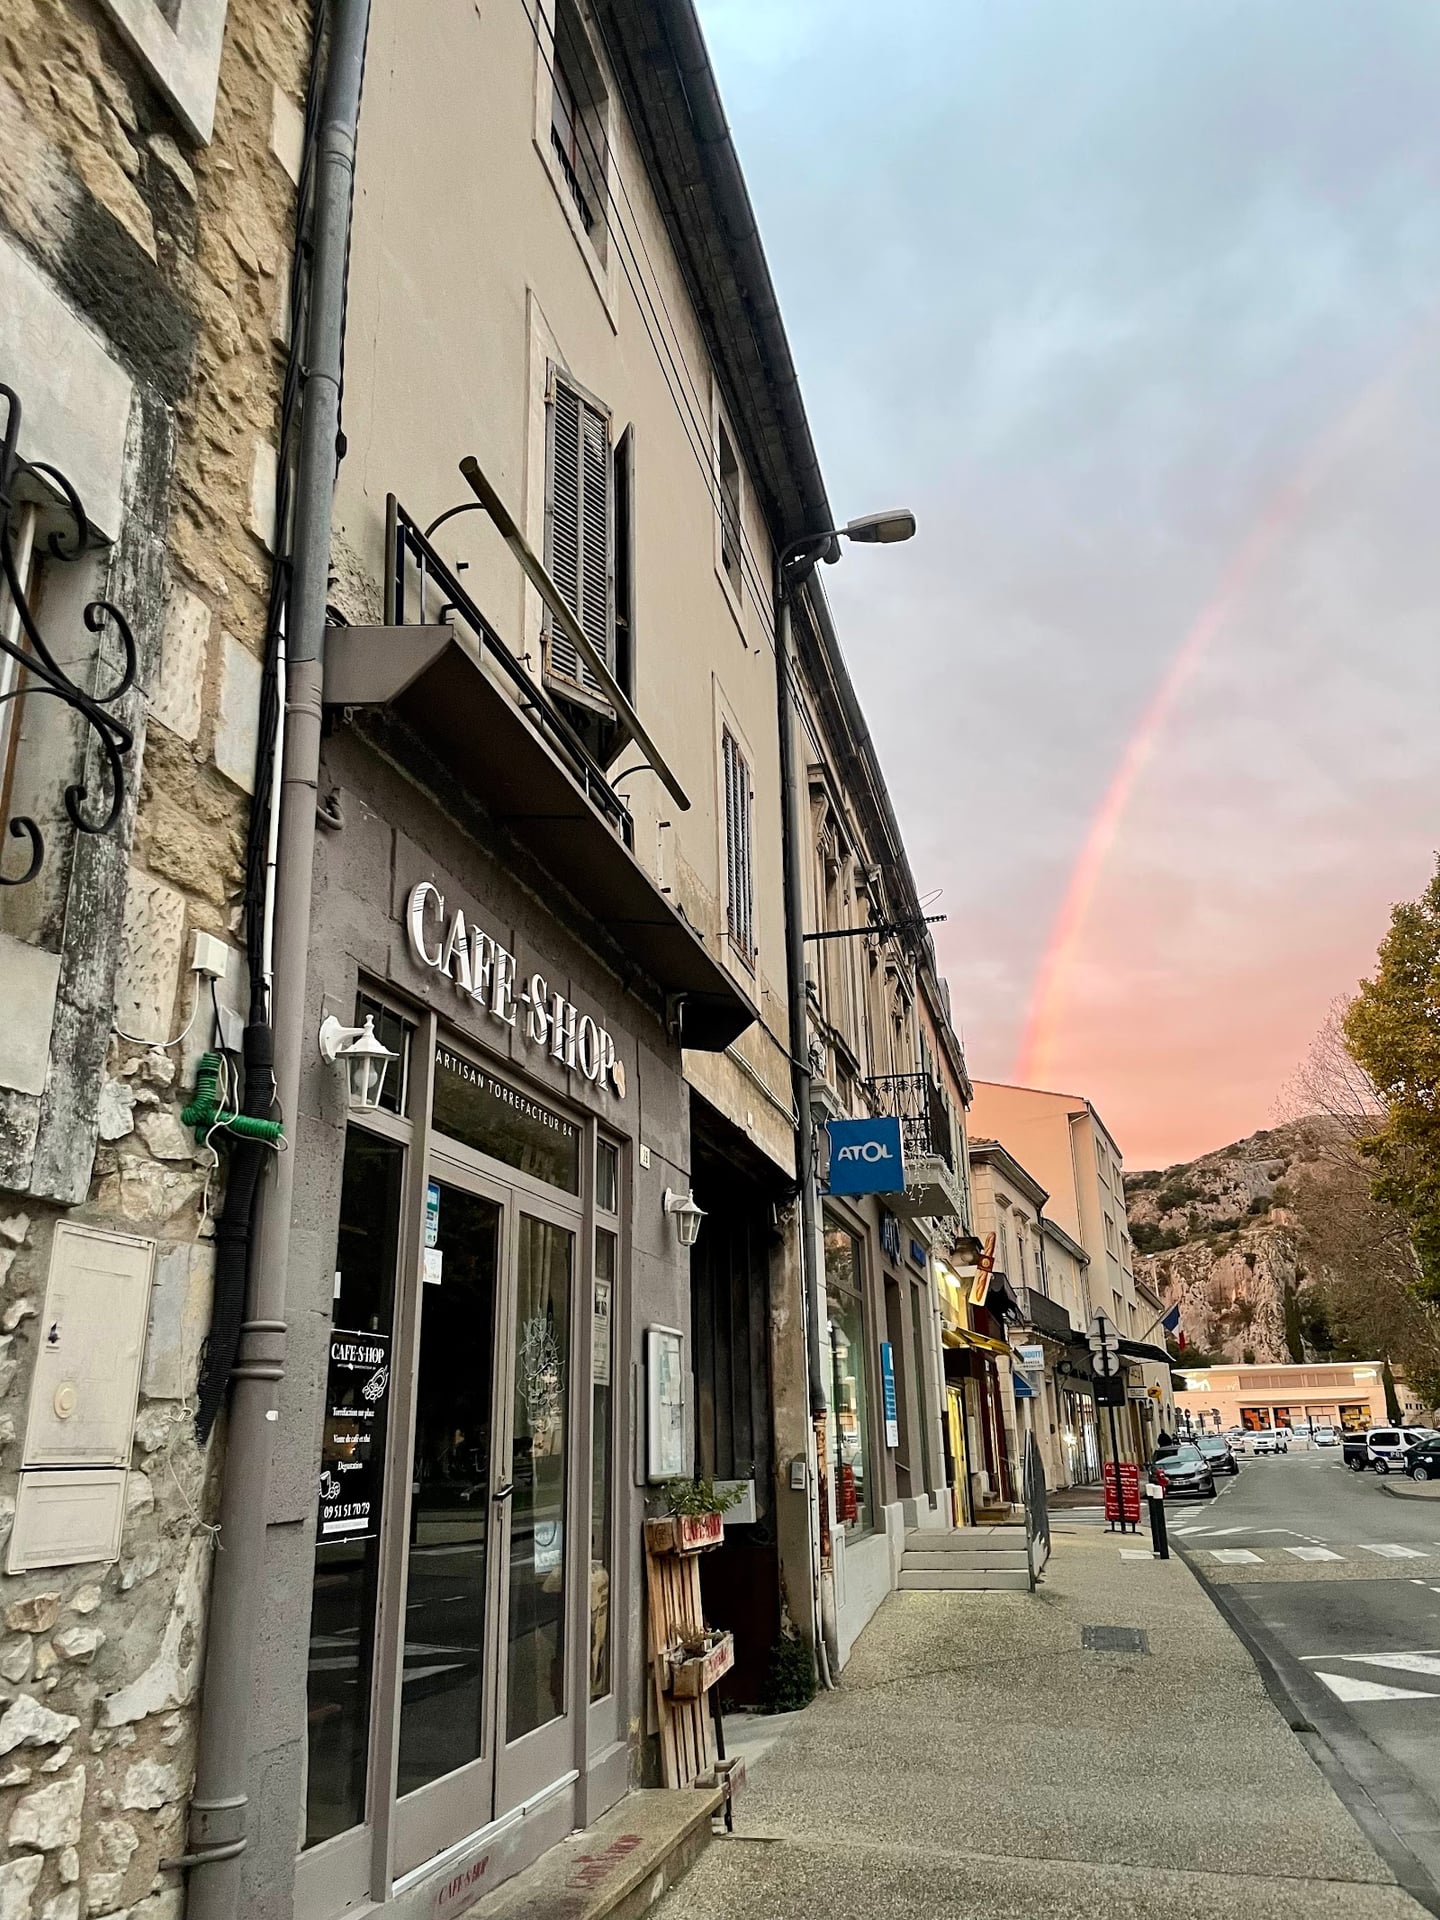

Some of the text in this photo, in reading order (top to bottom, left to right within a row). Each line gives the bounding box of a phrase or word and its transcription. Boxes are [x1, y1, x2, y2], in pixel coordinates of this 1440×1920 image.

[435, 1049, 574, 1137] ARTISAN TORREFACTEUR 84
[838, 1141, 893, 1163] ATOL
[324, 1501, 370, 1519] 09 51 51 70 79
